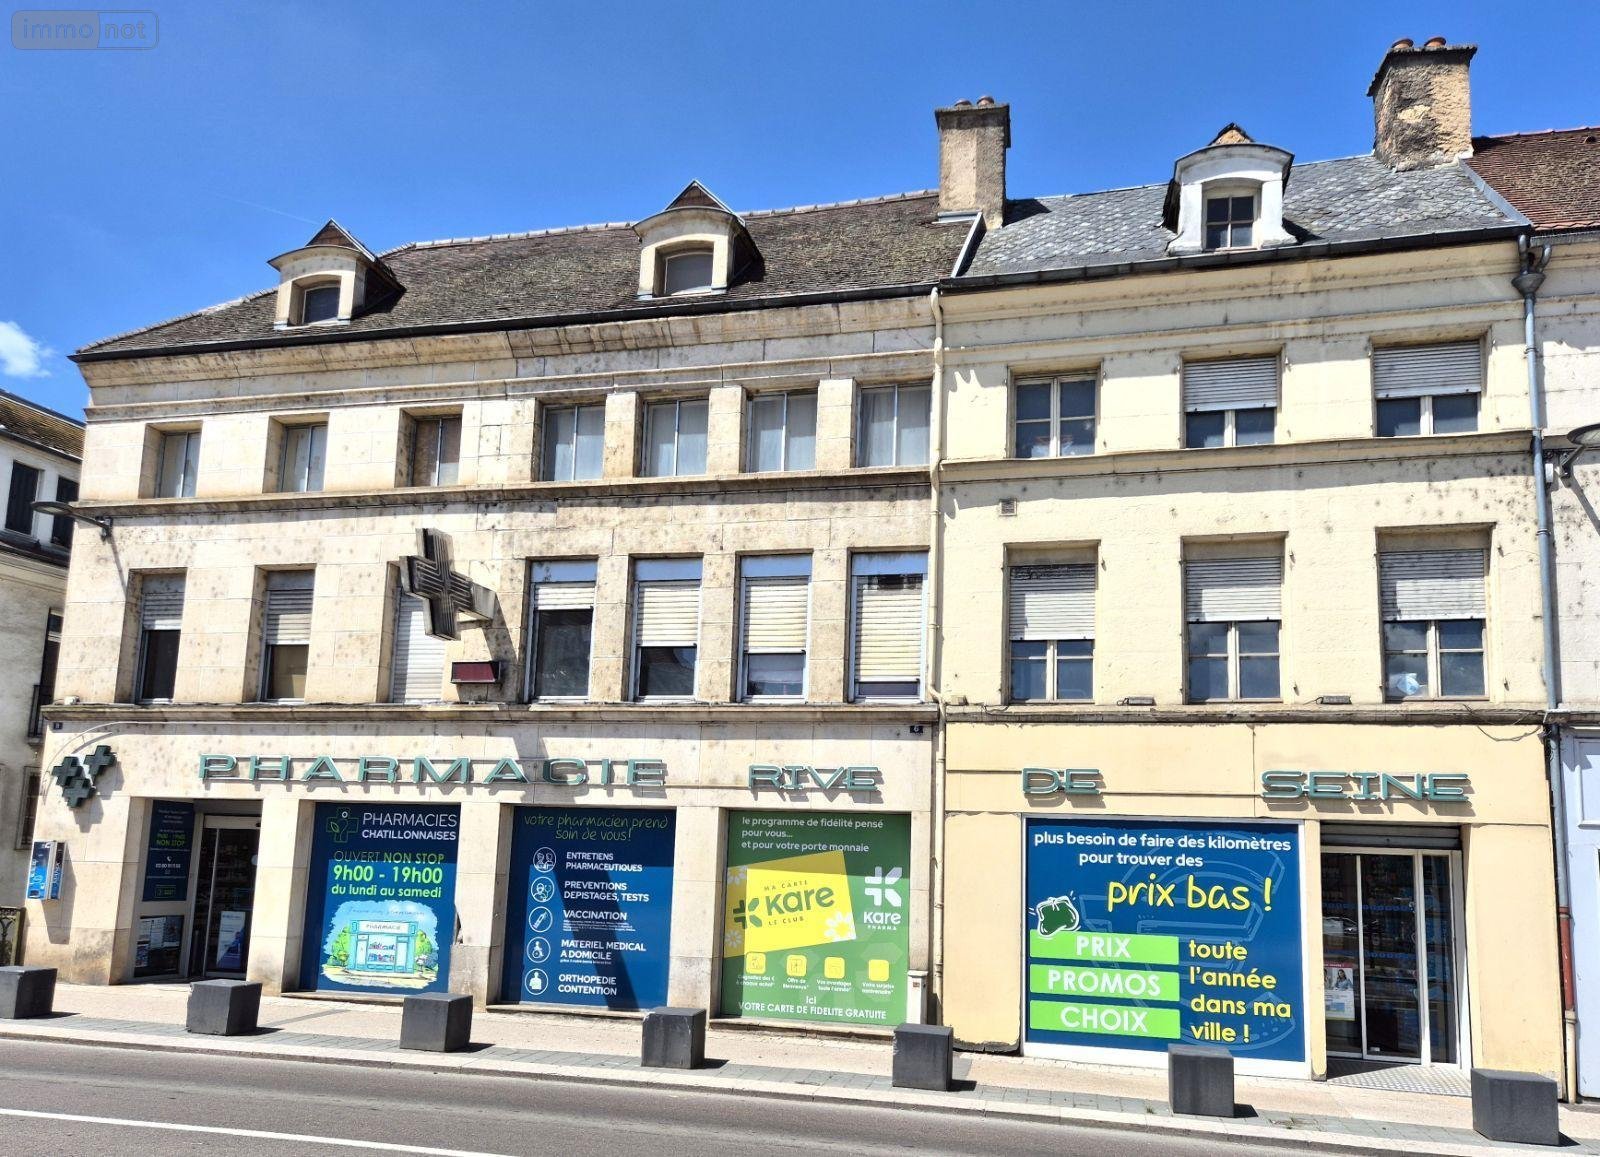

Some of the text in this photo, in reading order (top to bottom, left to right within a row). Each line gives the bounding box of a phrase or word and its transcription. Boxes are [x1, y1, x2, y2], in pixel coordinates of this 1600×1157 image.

[198, 754, 1470, 802] PHARMACIE RIVE DE SEINE
[362, 812, 458, 828] PHARMACIES
[524, 814, 668, 830] votre pharmacien prend
[742, 816, 884, 830] le programme de fidélité pensé
[362, 830, 456, 840] CHATILLONNAISES
[556, 828, 633, 842] soin de vous!
[742, 830, 793, 838] pour vous...
[741, 841, 870, 852] et pour votre porte monnaie
[1034, 832, 1291, 851] plus besoin de faire des kilomètres
[334, 850, 445, 864] OUVERT NON STOP
[566, 852, 614, 861] ENTRETIENS
[1079, 852, 1204, 868] pour trouver des
[566, 862, 642, 872] PHARMACEUTIQUES
[333, 865, 374, 882] 9h00
[393, 866, 443, 884] 19h00
[332, 884, 442, 898] du lundi au samedi
[564, 881, 627, 890] PREVENTIONS
[781, 880, 808, 889] CARTE
[564, 892, 650, 902] DEPISTAGES, TESTS
[1107, 873, 1272, 912] prix bas !
[764, 886, 834, 916] kare
[563, 910, 628, 920] VACCINATION
[782, 916, 804, 924] CLUB
[561, 940, 646, 952] MATERIEL MEDICAL
[1076, 936, 1131, 958] PRIX
[1188, 940, 1248, 961] toute
[560, 950, 612, 960] A DOMICILE
[558, 974, 616, 985] ORTHOPEDIE
[1048, 970, 1161, 996] PROMOS
[1189, 966, 1278, 990] l'année
[558, 985, 617, 996] CONTENTION
[738, 1001, 886, 1020] VOTRE CARTE DE FIDELITE GRATUITE
[1191, 994, 1292, 1018] dans ma
[1060, 1006, 1148, 1032] CHOIX
[1191, 1022, 1250, 1044] ville !
